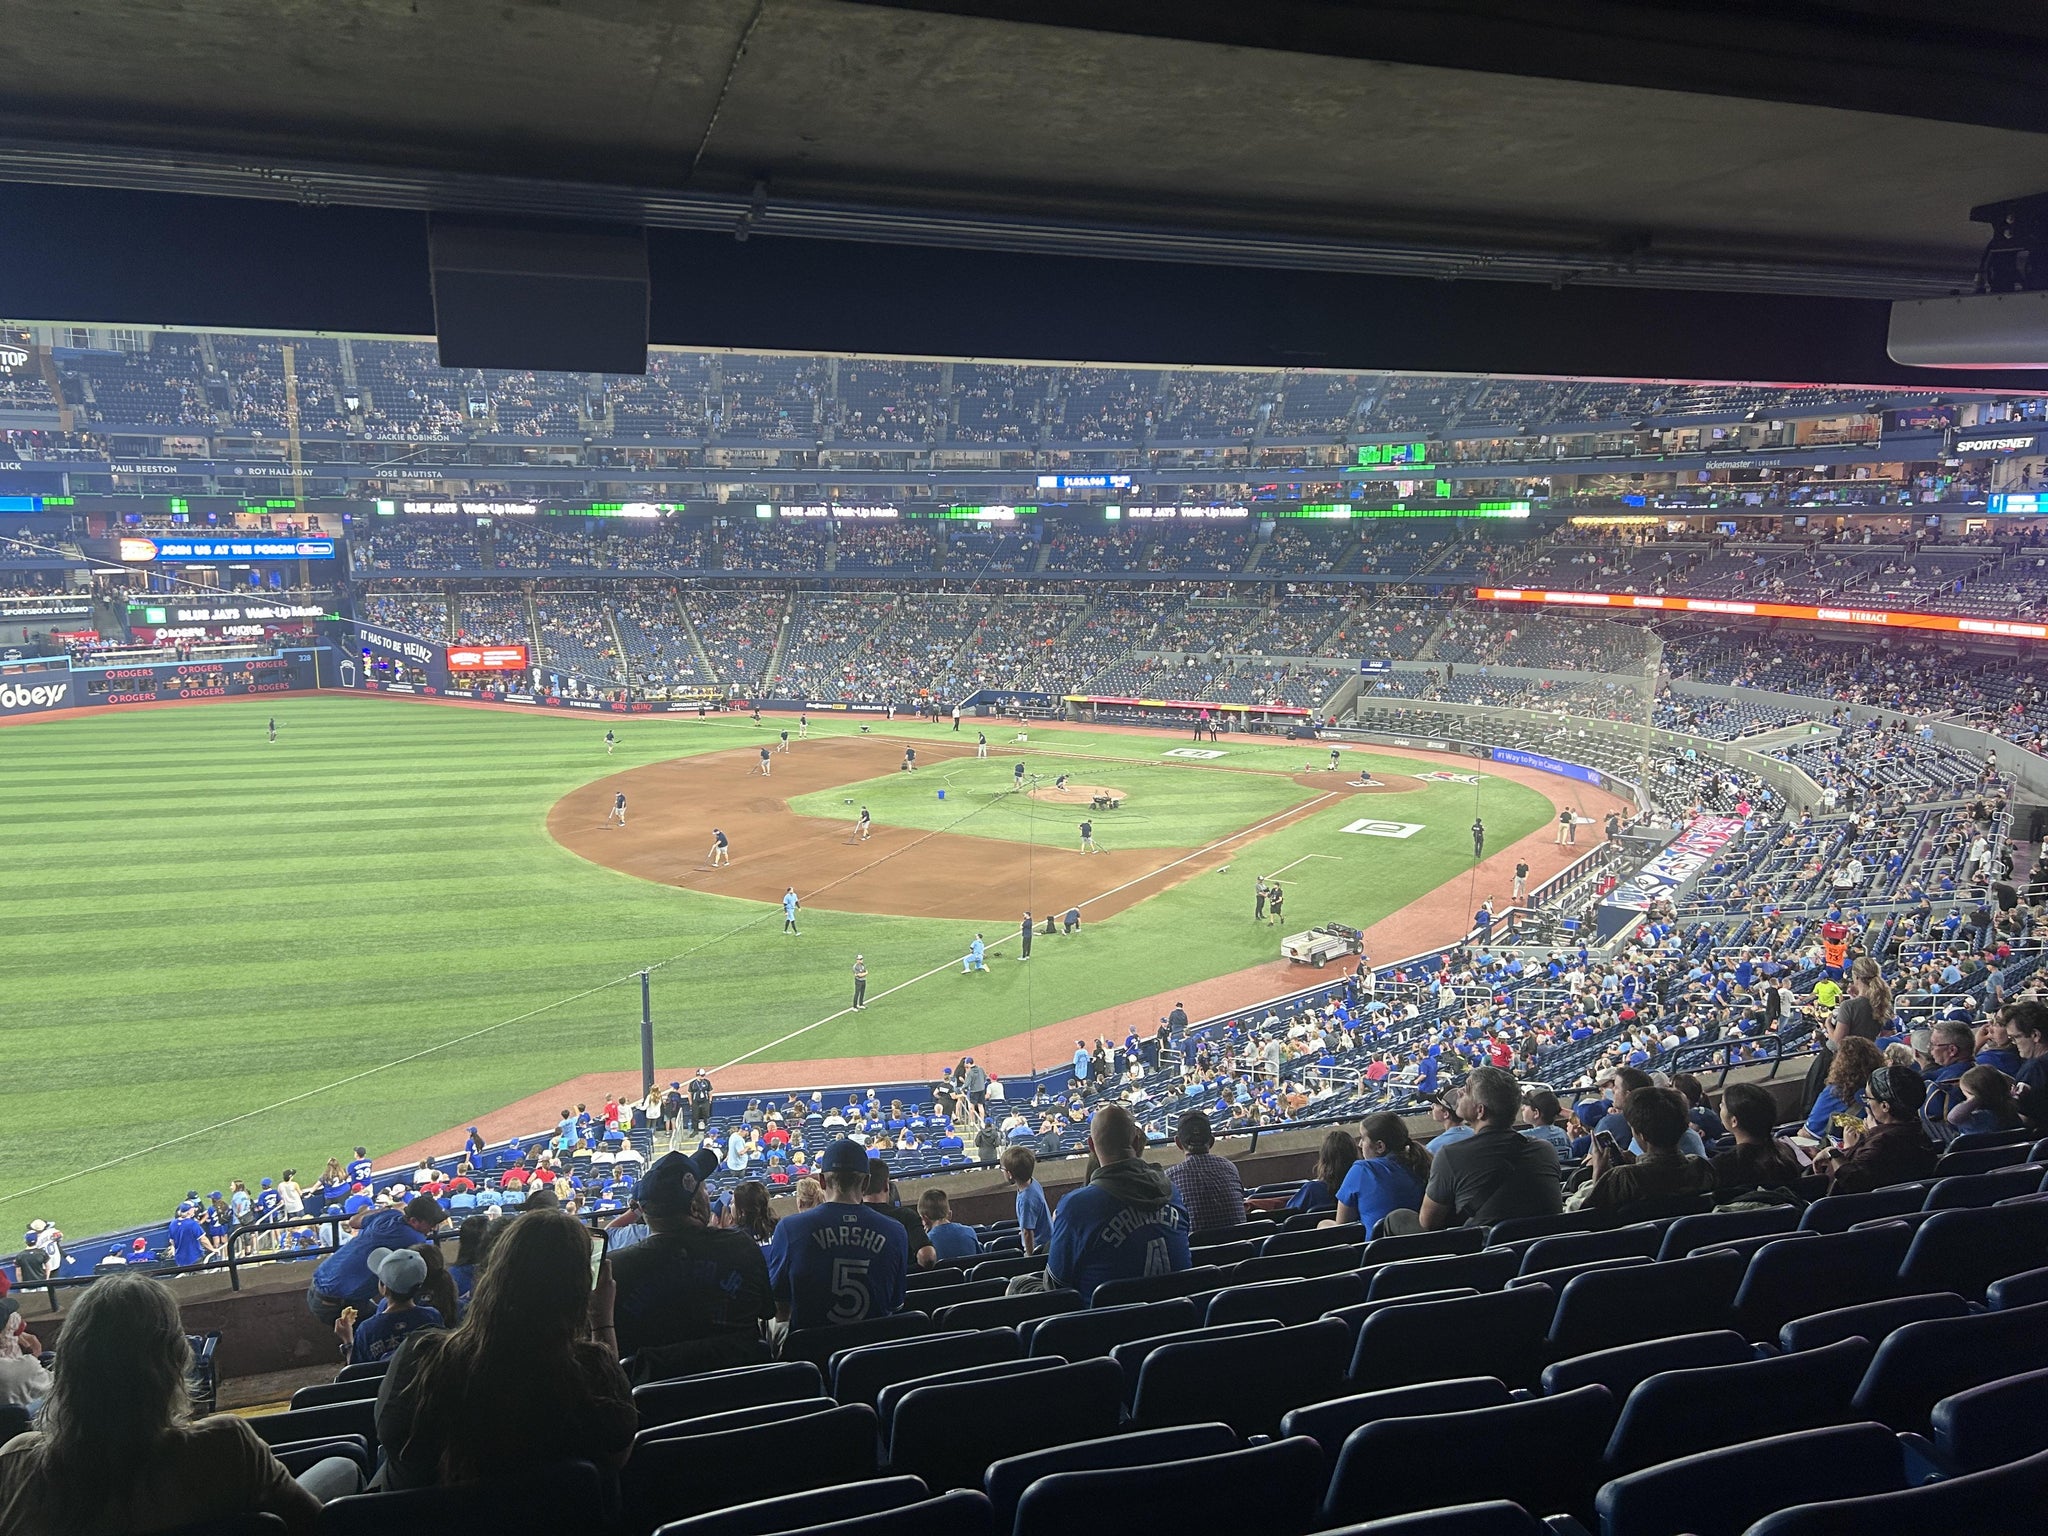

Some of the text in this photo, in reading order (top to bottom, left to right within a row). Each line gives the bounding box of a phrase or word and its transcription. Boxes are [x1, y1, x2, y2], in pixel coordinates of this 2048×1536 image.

[1956, 437, 2034, 452] SPORTSNET
[110, 465, 177, 473] PAUL BEESTON
[248, 468, 314, 477] ROY HALLADAY
[376, 469, 398, 478] JOSÉ
[780, 506, 803, 517] BLUE
[804, 506, 828, 517] JAYS
[870, 506, 899, 517] Music
[1128, 507, 1151, 517] BLUE
[1152, 507, 1176, 517] JAYS
[1220, 506, 1249, 518] Music
[3, 608, 54, 616] SPORTSBOOK
[1851, 612, 1887, 623] TERRACE
[360, 629, 433, 664] IT HAS TO BE HEINZ
[188, 664, 224, 673] ROGERS
[256, 660, 289, 669] ROGERS
[116, 668, 154, 678] ROGERS
[191, 687, 225, 697] ROGERS
[257, 683, 290, 692] ROGERS
[119, 692, 156, 703] ROGERS
[631, 703, 653, 711] HEINZ
[1505, 752, 1520, 763] Way
[1520, 755, 1529, 764] to
[1528, 756, 1538, 767] Pay
[1543, 760, 1563, 772] Canada
[355, 1167, 371, 1180] 39
[812, 1226, 886, 1254] VARSHO
[826, 1258, 871, 1325] 5
